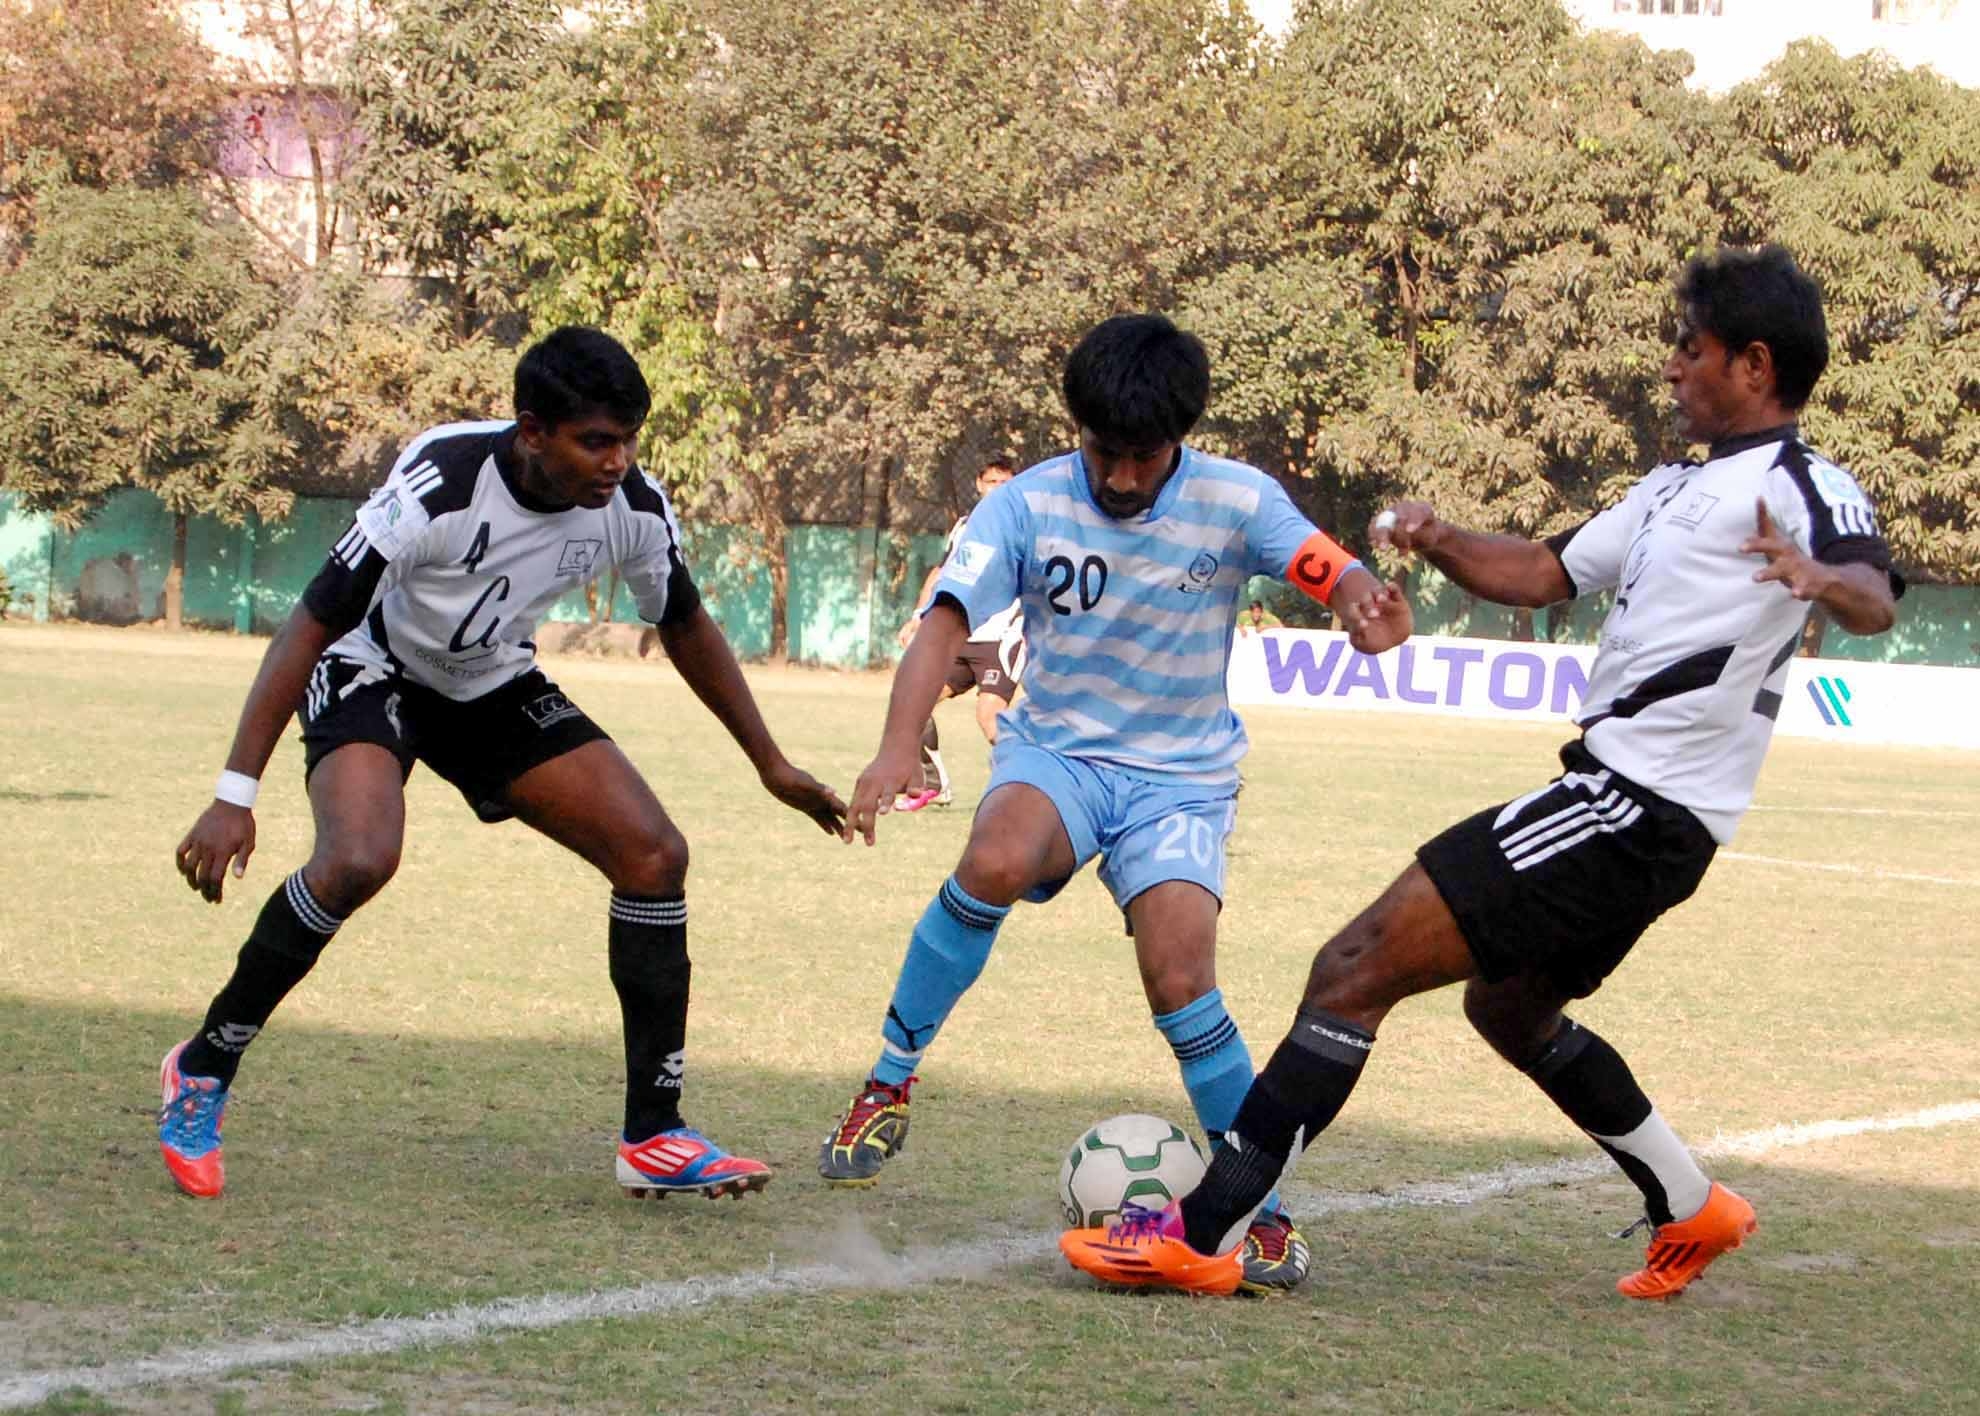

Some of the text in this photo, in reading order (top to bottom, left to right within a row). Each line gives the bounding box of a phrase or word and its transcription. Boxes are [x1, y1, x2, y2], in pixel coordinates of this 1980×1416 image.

[461, 521, 490, 573] 4
[1296, 552, 1331, 586] C
[1045, 555, 1108, 616] 20
[1262, 636, 1592, 713] WALTON
[1154, 812, 1214, 868] 20
[1310, 1024, 1372, 1050] adida
[654, 1074, 684, 1088] Lot
